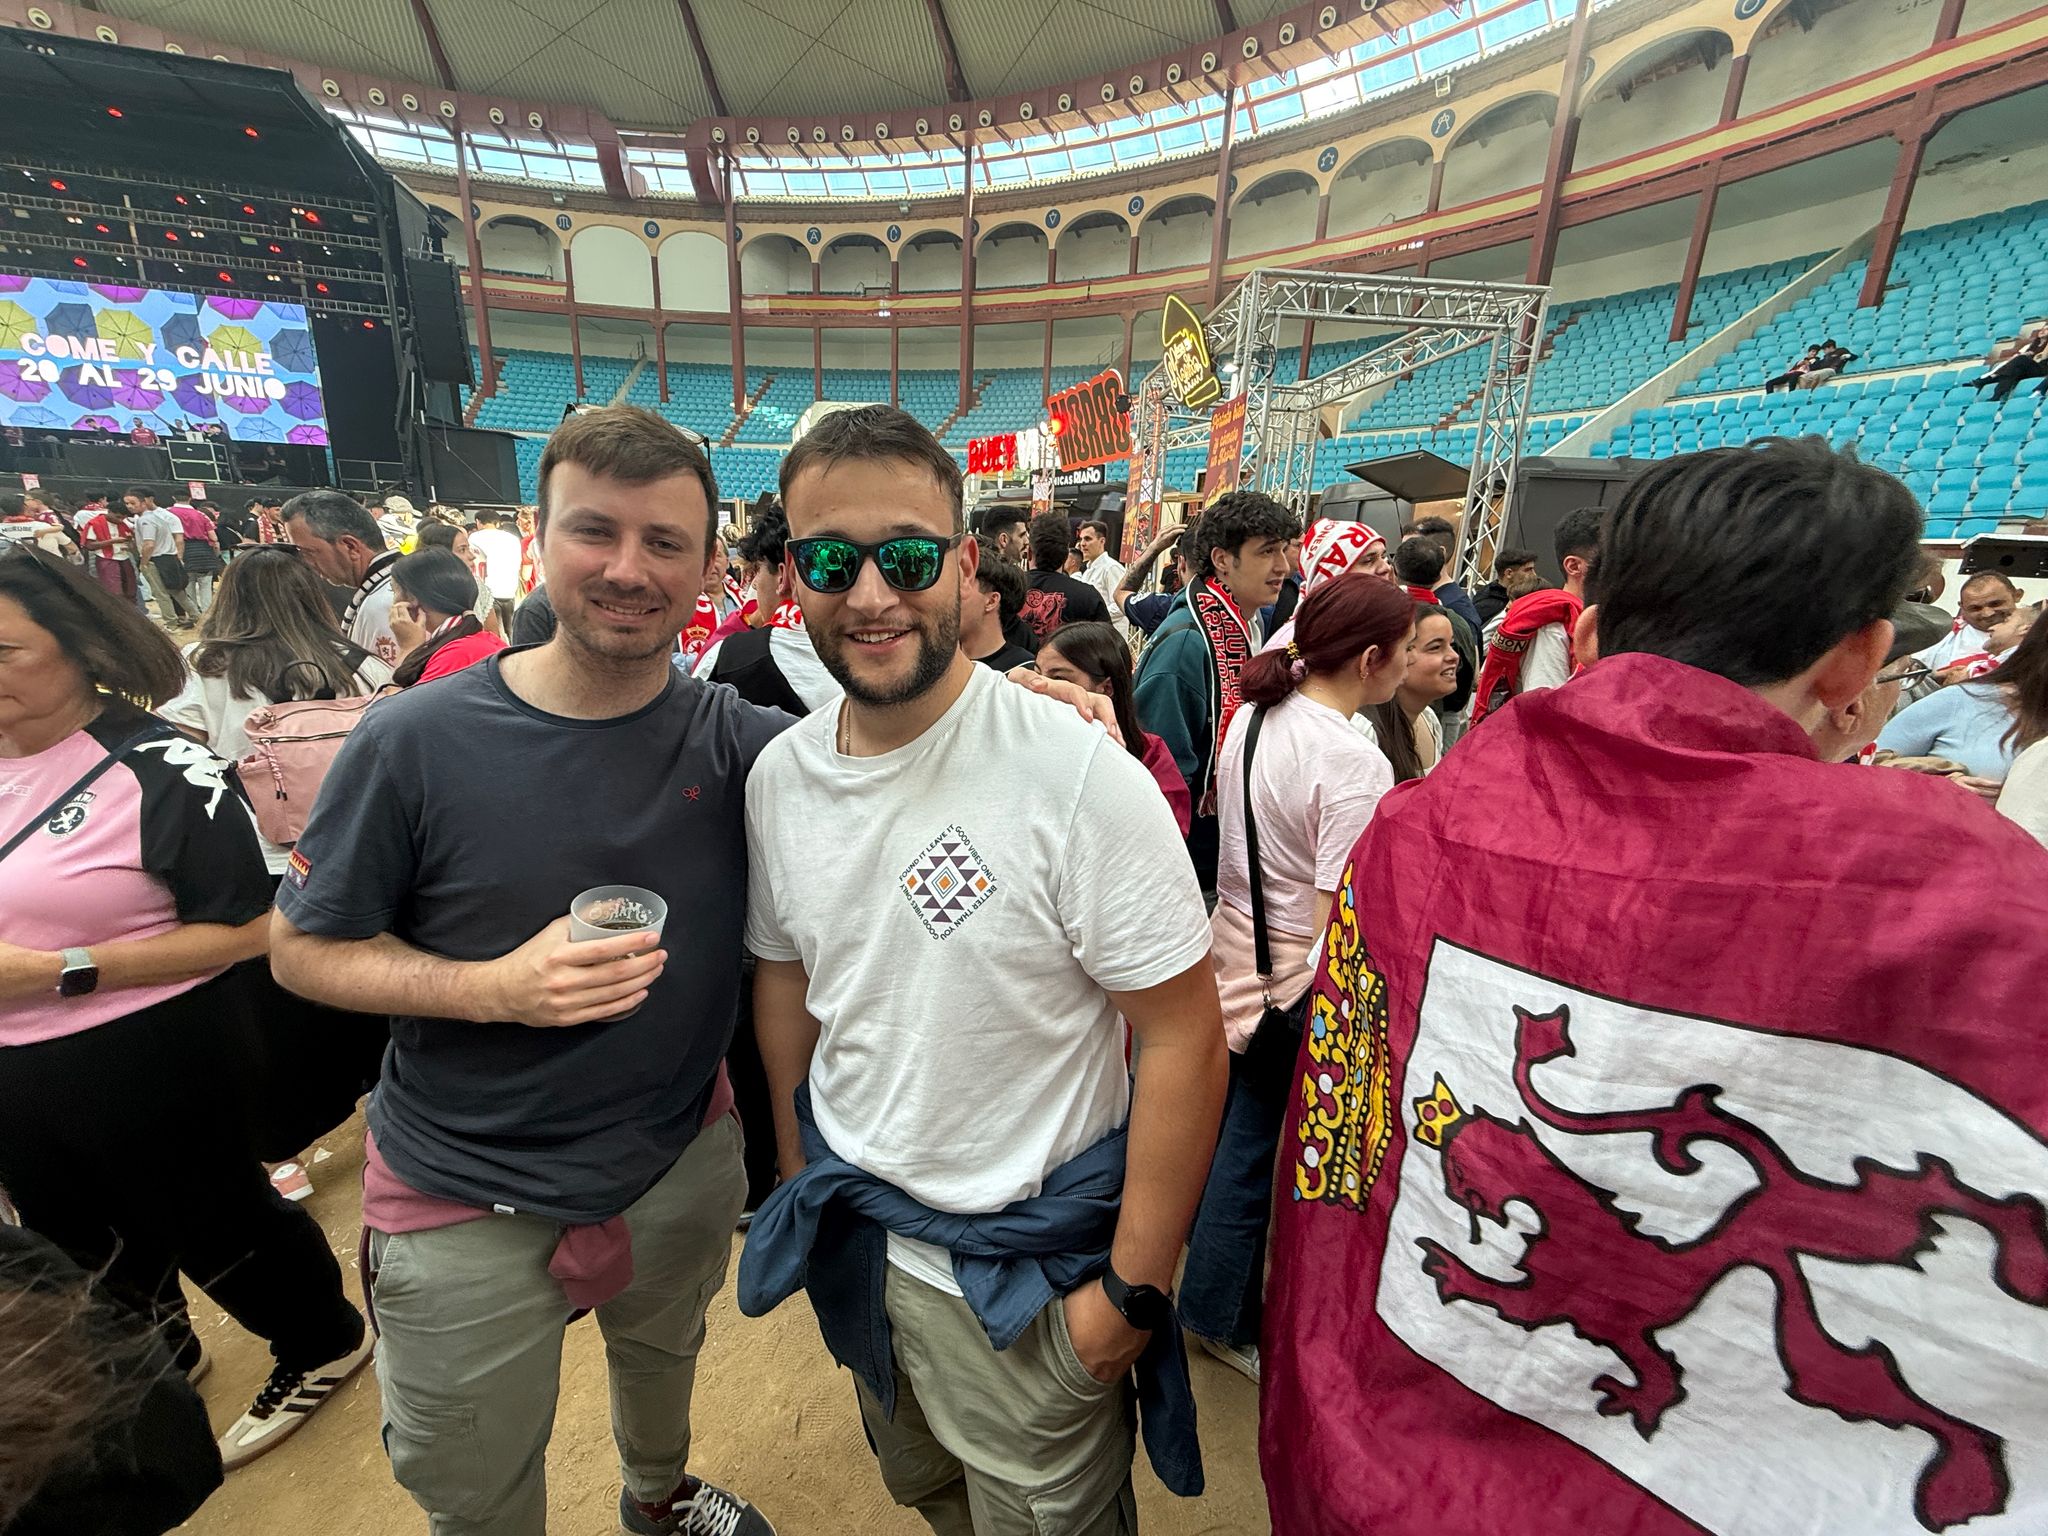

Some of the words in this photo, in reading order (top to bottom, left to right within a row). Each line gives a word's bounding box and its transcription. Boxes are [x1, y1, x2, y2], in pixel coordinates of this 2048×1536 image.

[20, 332, 120, 363] COME
[136, 341, 157, 366] Y
[177, 345, 275, 376] CALLE
[17, 357, 60, 383] 20
[79, 363, 123, 388] AL
[137, 367, 178, 392] 29
[194, 372, 286, 401] JUNIO
[1073, 467, 1101, 484] RIAÑO
[899, 858, 920, 882] FOUND
[926, 832, 948, 853] LEAVE
[947, 823, 955, 833] IT
[955, 825, 971, 846] GOOD
[968, 845, 984, 866] VIBES
[981, 864, 997, 883] ONLY
[900, 883, 913, 901] ONLY
[971, 884, 998, 910] BETTER
[910, 899, 924, 920] VIBES
[954, 908, 974, 928] THAN
[923, 919, 940, 940] GOOD
[940, 926, 956, 941] YOU
